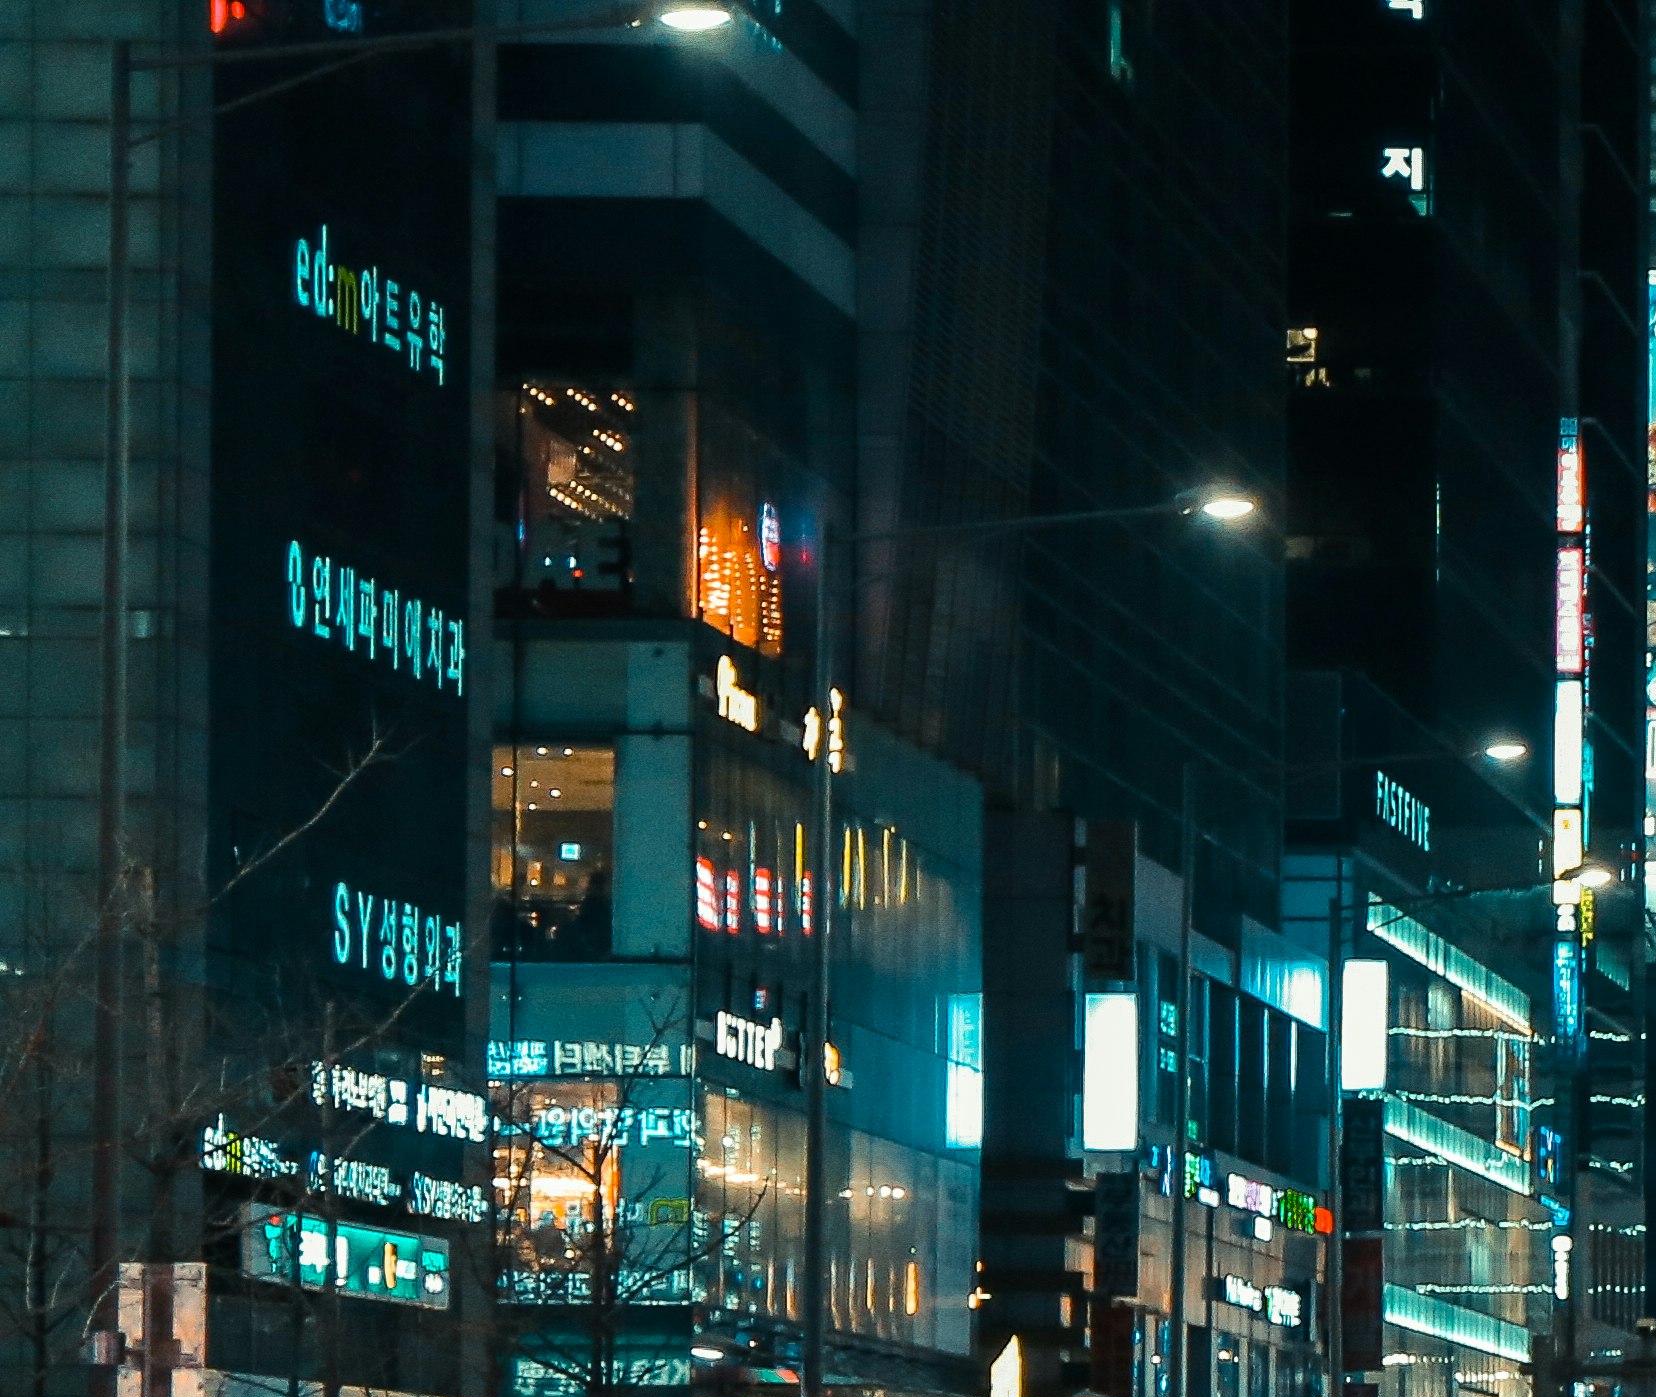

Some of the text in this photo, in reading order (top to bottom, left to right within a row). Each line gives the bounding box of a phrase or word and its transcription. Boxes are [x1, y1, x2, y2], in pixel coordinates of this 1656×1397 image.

[1382, 147, 1424, 191] 지
[1376, 770, 1430, 852] FASTFIVE
[333, 880, 462, 998] SY성형외과
